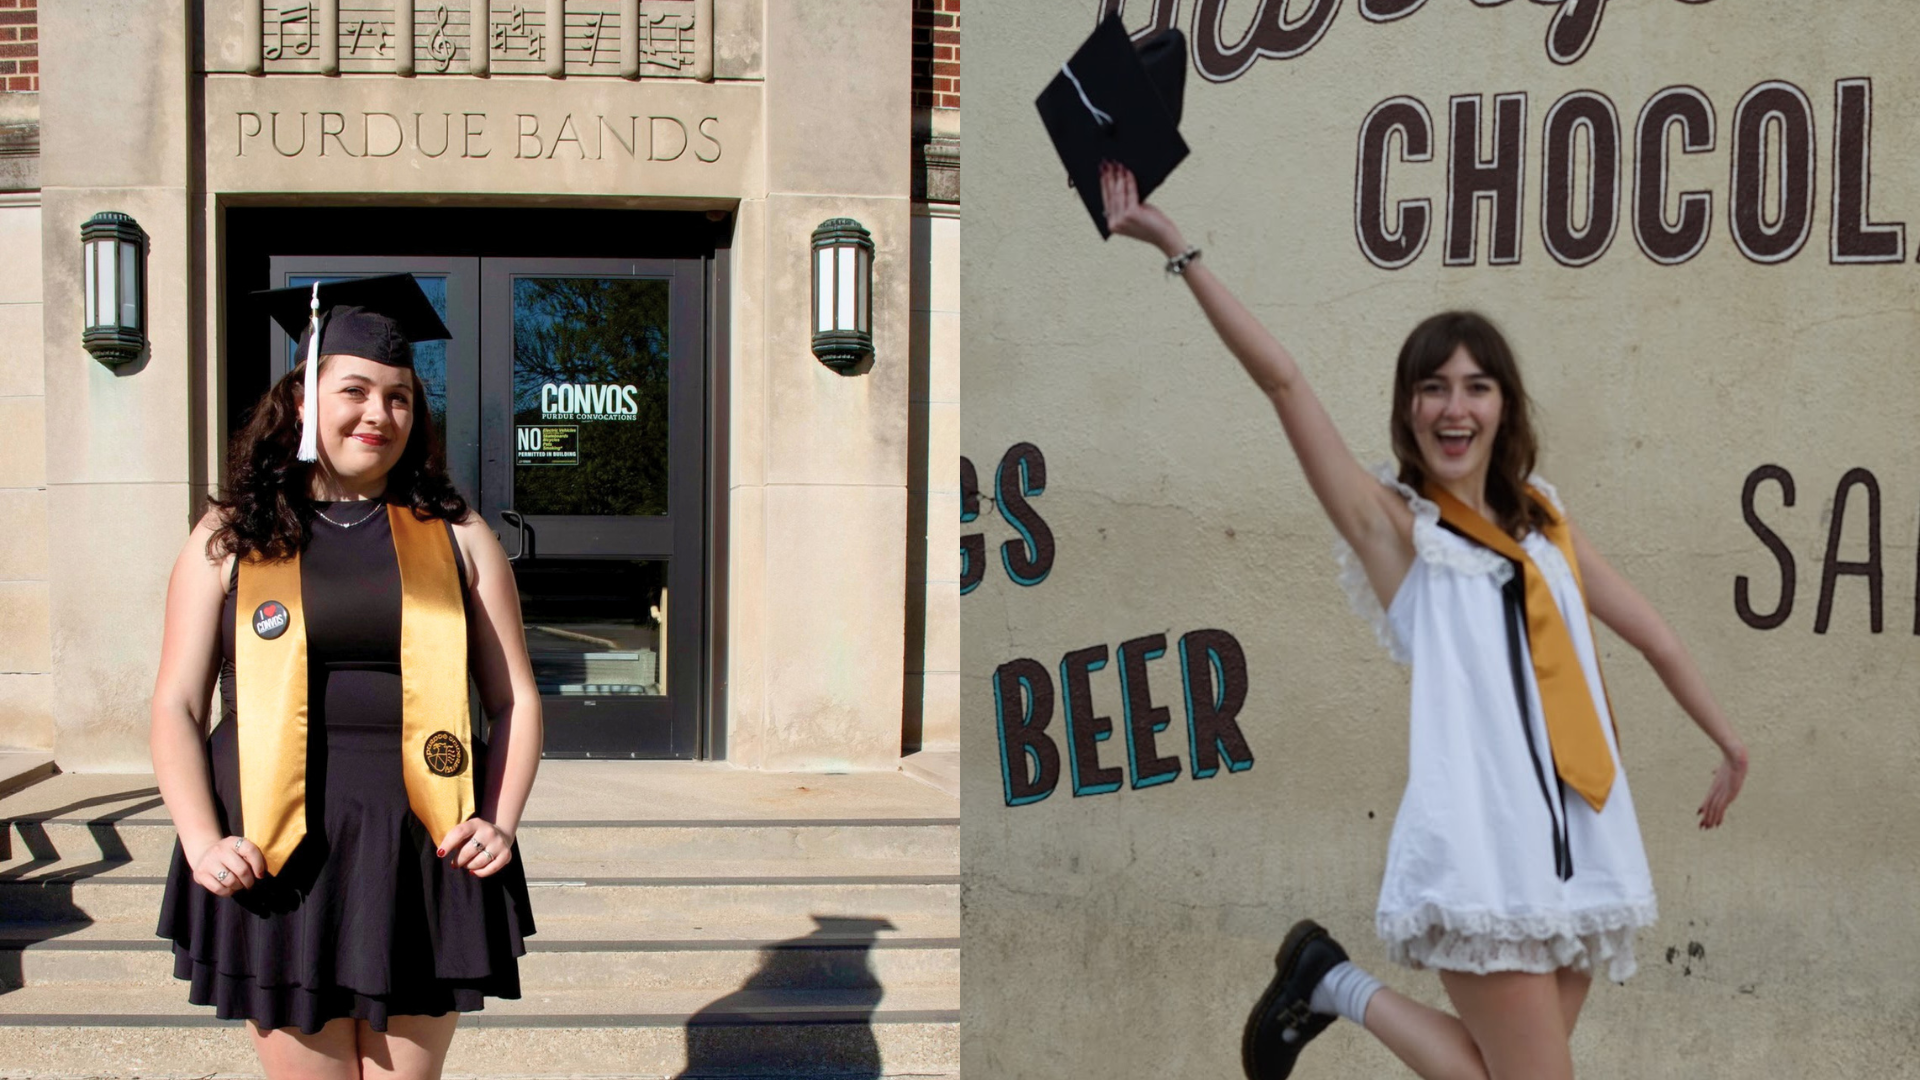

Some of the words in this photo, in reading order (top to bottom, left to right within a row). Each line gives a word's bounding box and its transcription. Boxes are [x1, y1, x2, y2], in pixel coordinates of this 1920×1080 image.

[235, 111, 492, 159] PURDUE
[514, 112, 723, 164] BANDS
[1354, 78, 1920, 270] CHOCOL
[541, 383, 638, 415] CONVOS
[517, 427, 542, 451] NO
[1734, 463, 1920, 636] SA
[256, 613, 284, 634] CONVOS
[992, 628, 1254, 808] BEER
